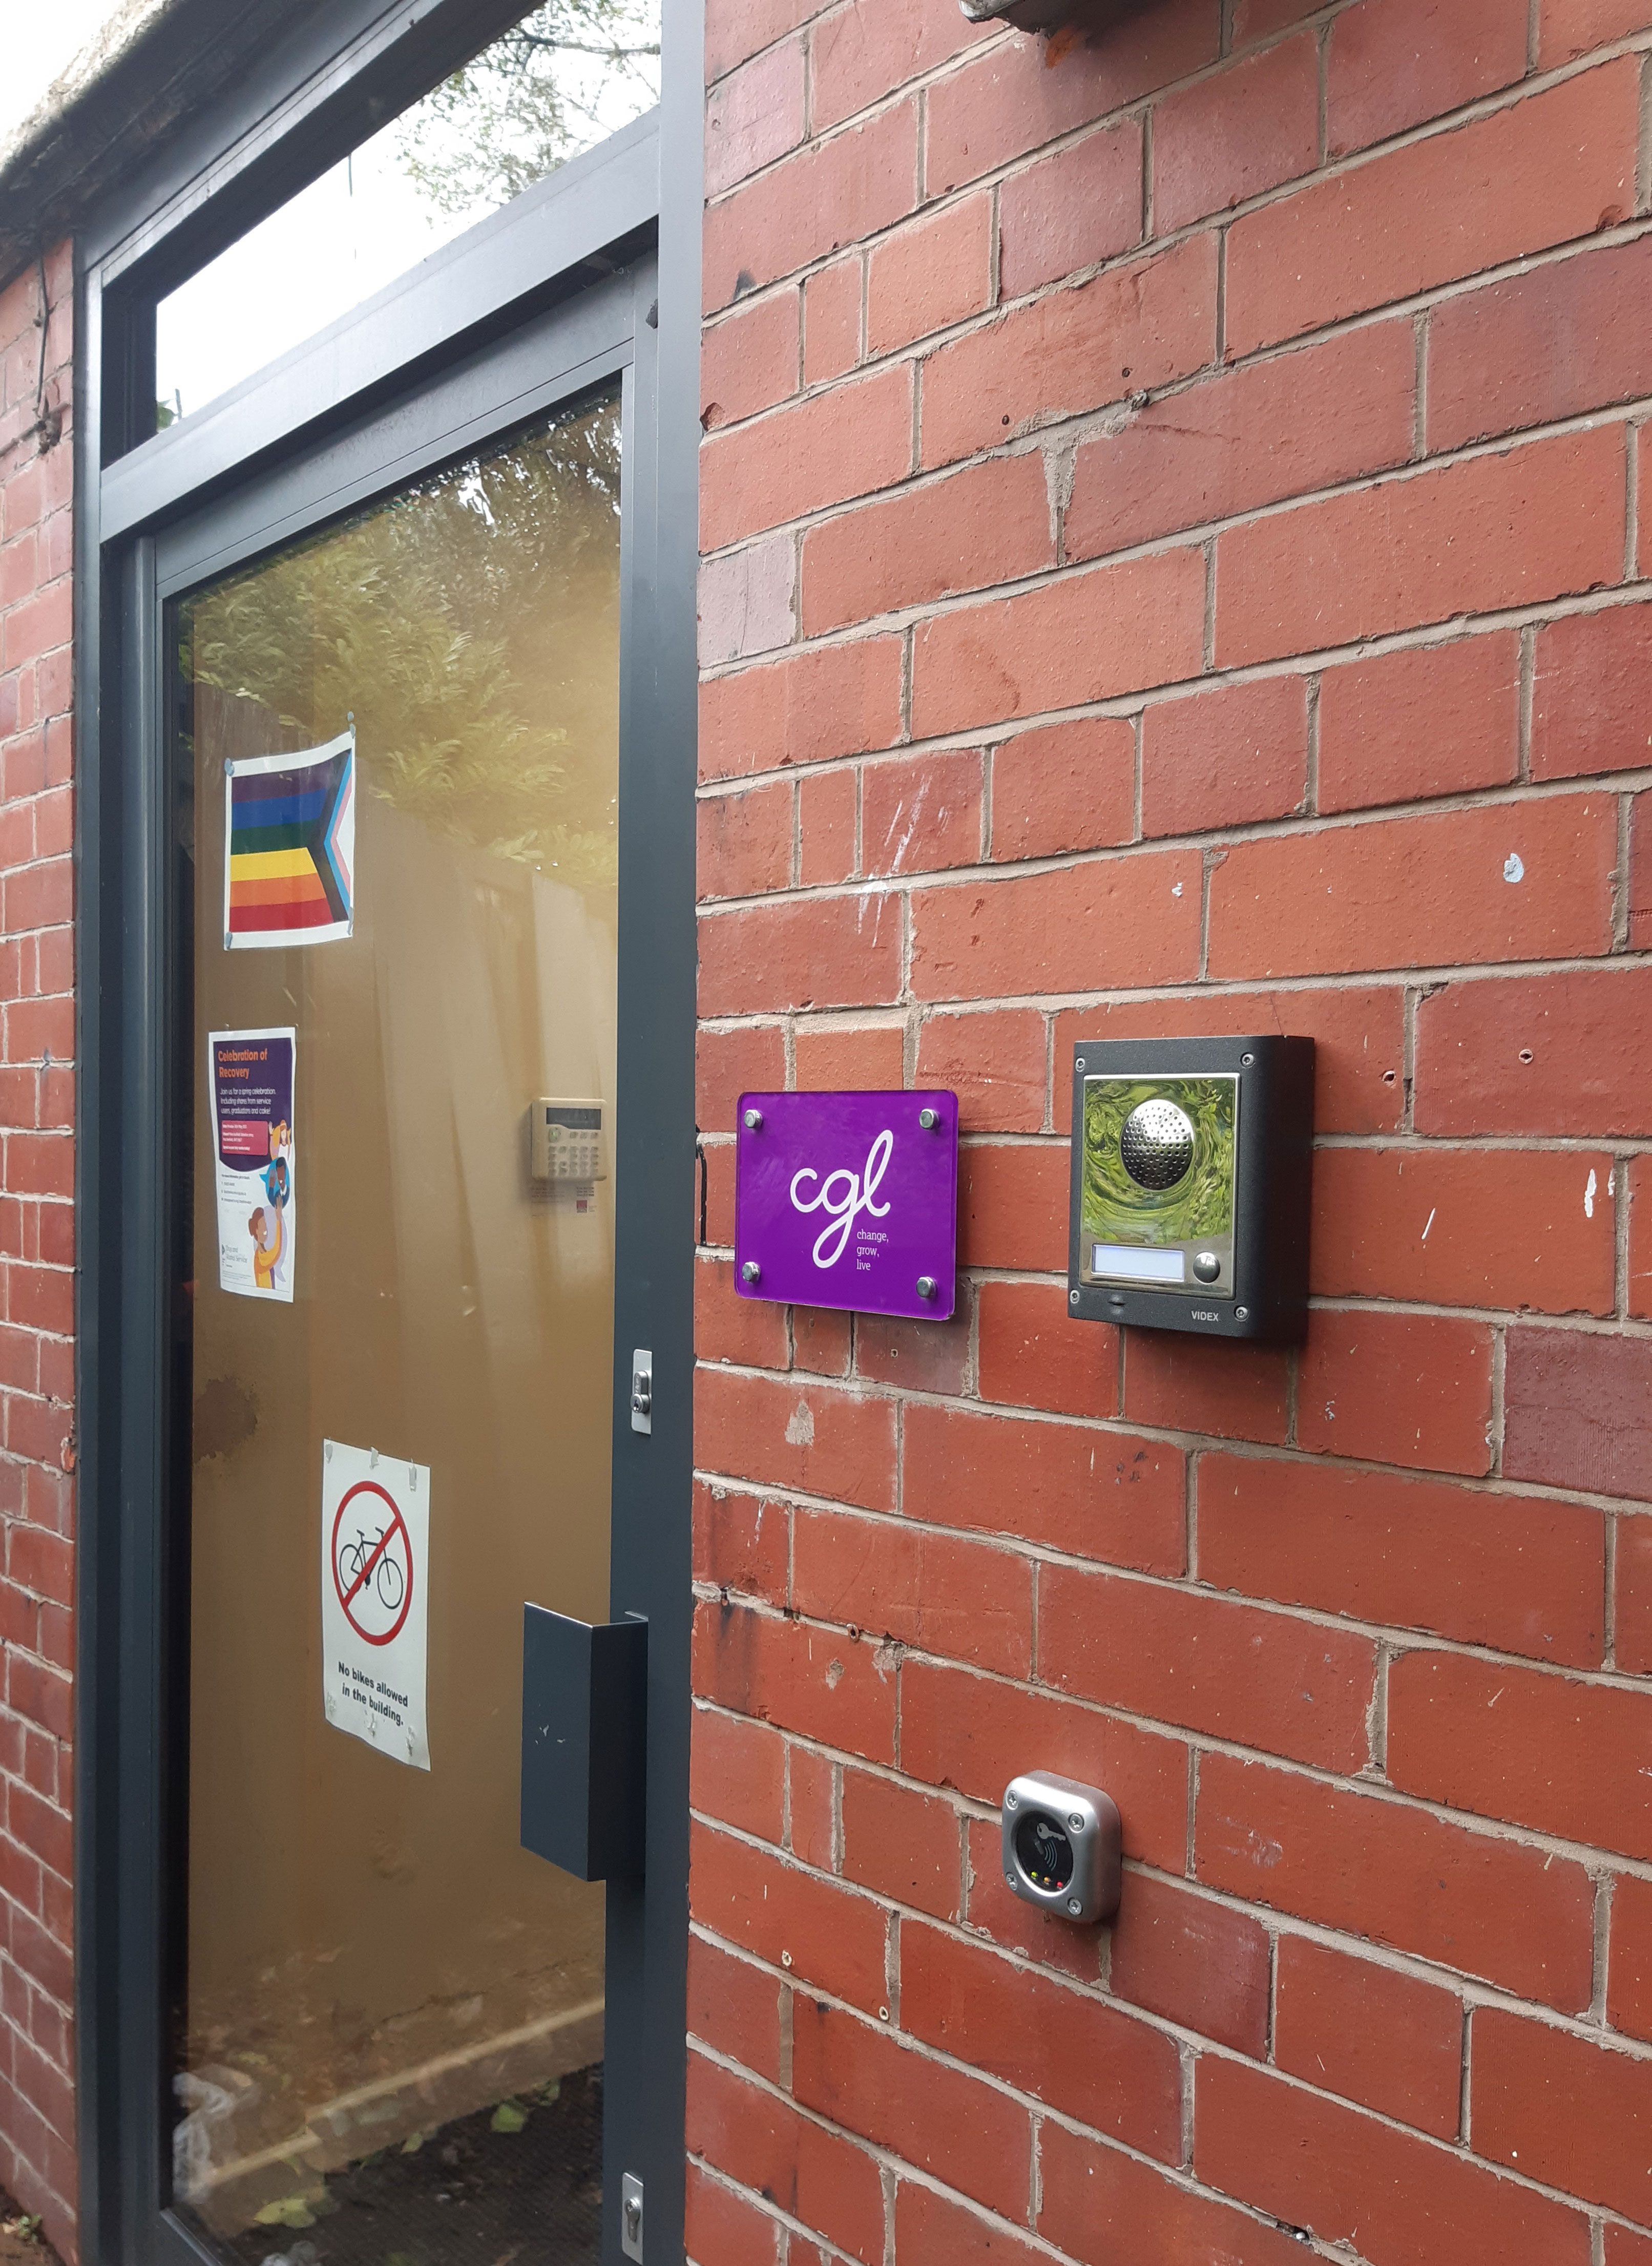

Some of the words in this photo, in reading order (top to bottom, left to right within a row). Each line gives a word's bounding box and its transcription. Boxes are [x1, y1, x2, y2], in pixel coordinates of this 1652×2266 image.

[218, 1050, 258, 1062] Celebration
[260, 1048, 267, 1060] of
[219, 1066, 249, 1079] Recovery
[790, 1129, 893, 1268] cgl
[857, 1229, 889, 1243] change,
[856, 1246, 880, 1257] grow,
[856, 1259, 871, 1271] live
[1191, 1311, 1219, 1321] VIDEX
[339, 1661, 350, 1676] No
[352, 1668, 374, 1689] bikes
[377, 1682, 408, 1707] allowed
[342, 1683, 350, 1697] in
[353, 1689, 366, 1704] the
[369, 1695, 404, 1726] building.
